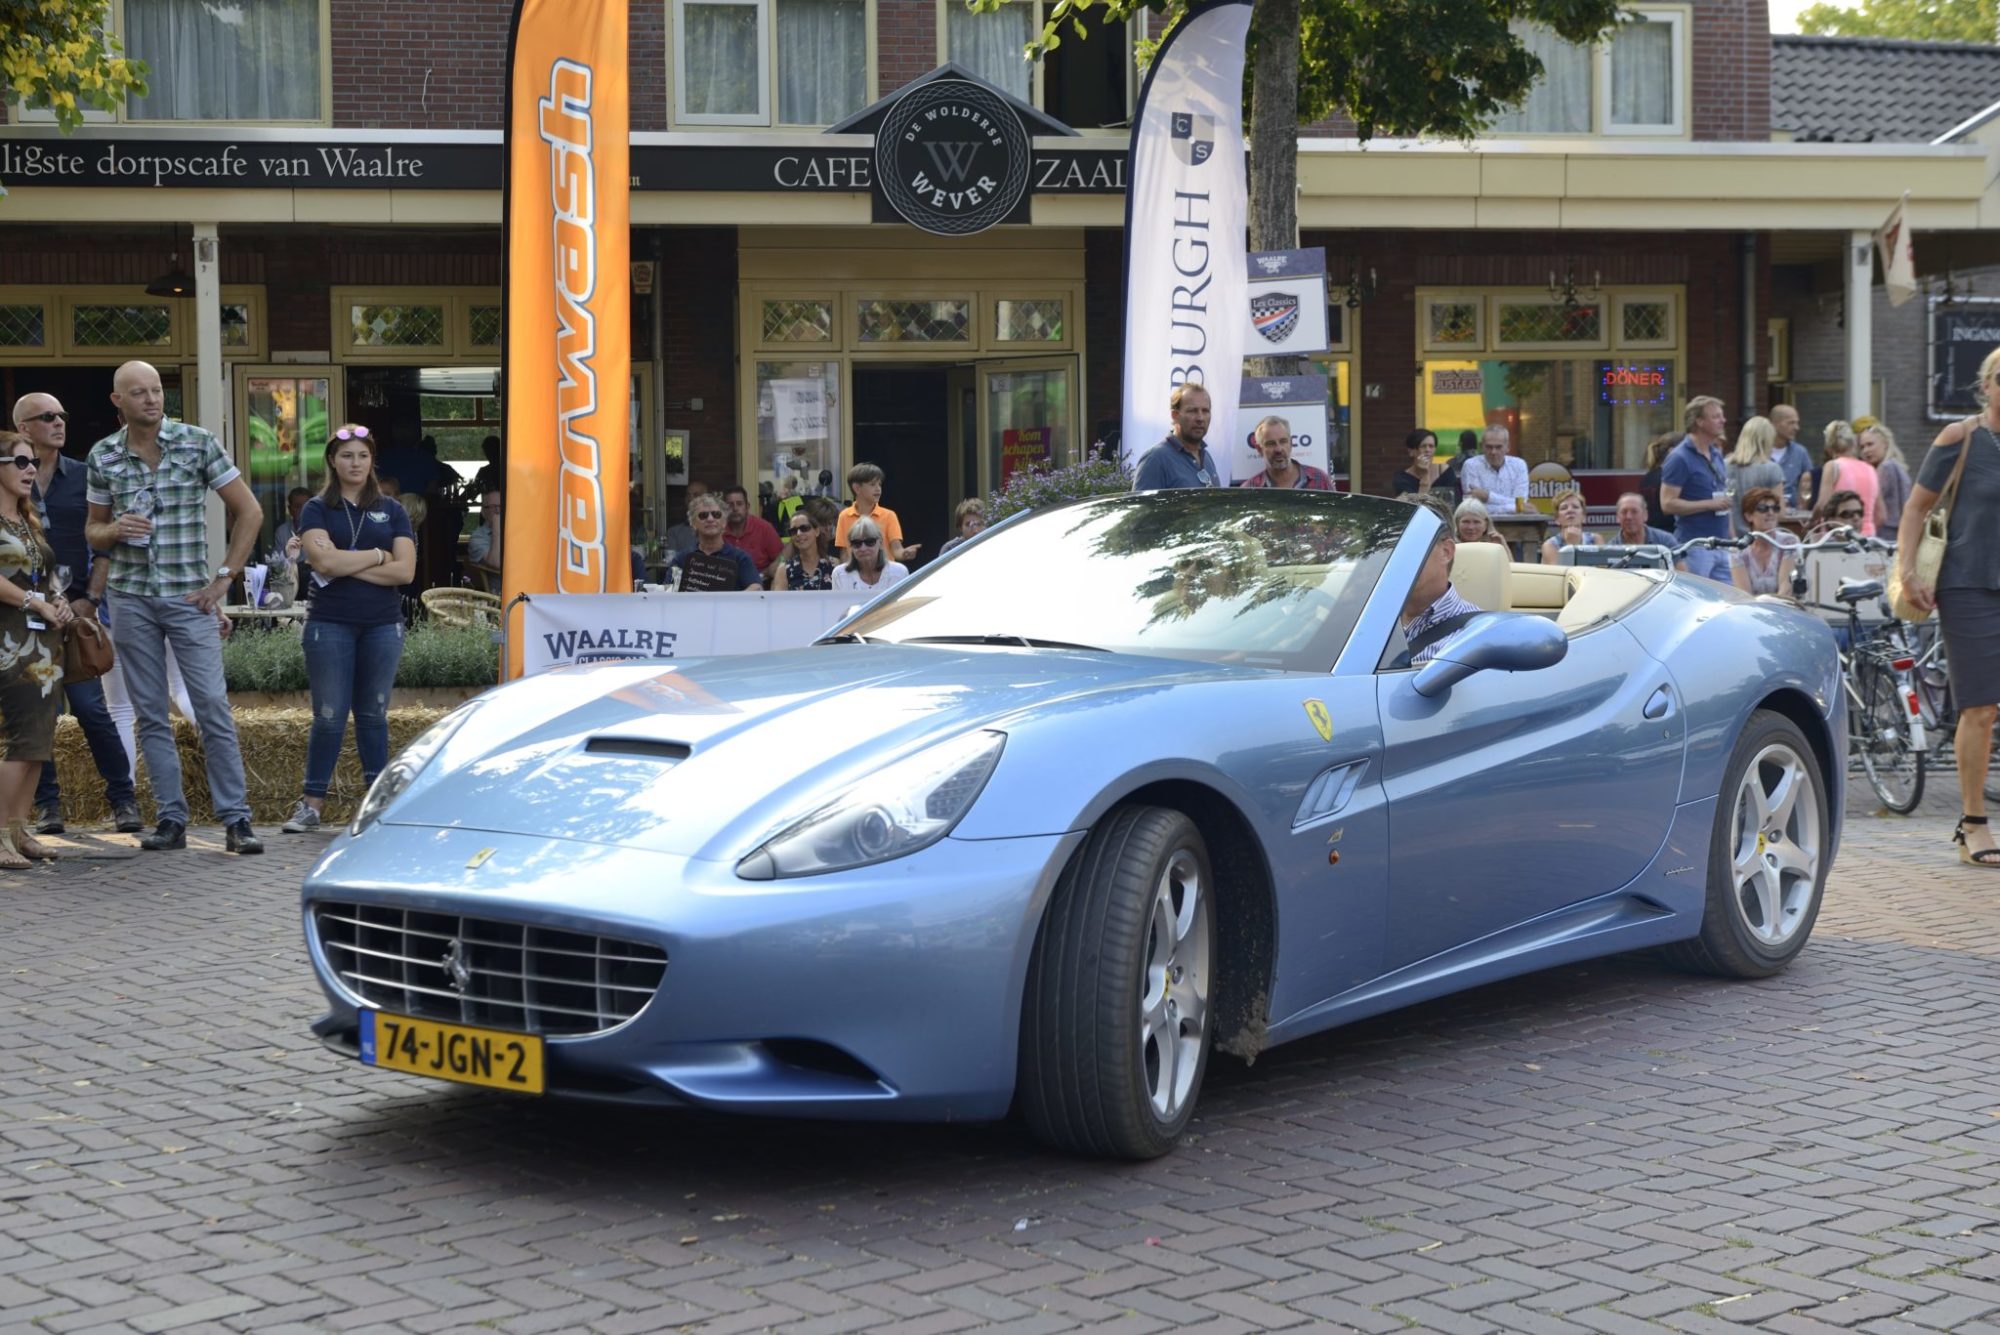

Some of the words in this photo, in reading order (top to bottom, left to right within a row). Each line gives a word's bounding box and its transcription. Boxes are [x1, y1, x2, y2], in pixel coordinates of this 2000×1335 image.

[905, 122, 922, 142] DE
[924, 105, 1002, 147] WOLDERSE
[97, 144, 248, 187] dorpscafe
[258, 158, 311, 177] van
[317, 147, 424, 177] Waalre
[774, 156, 872, 187] CAFE
[922, 141, 984, 182] W
[1035, 158, 1128, 188] ZAAL
[911, 171, 997, 210] WEVER
[1171, 188, 1212, 389] BURGH
[1267, 298, 1297, 307] Classics
[538, 57, 607, 594] carwash
[1605, 369, 1662, 386] DÖNER
[543, 629, 677, 660] WAALRE
[384, 1022, 527, 1083] 74-JGN-2
